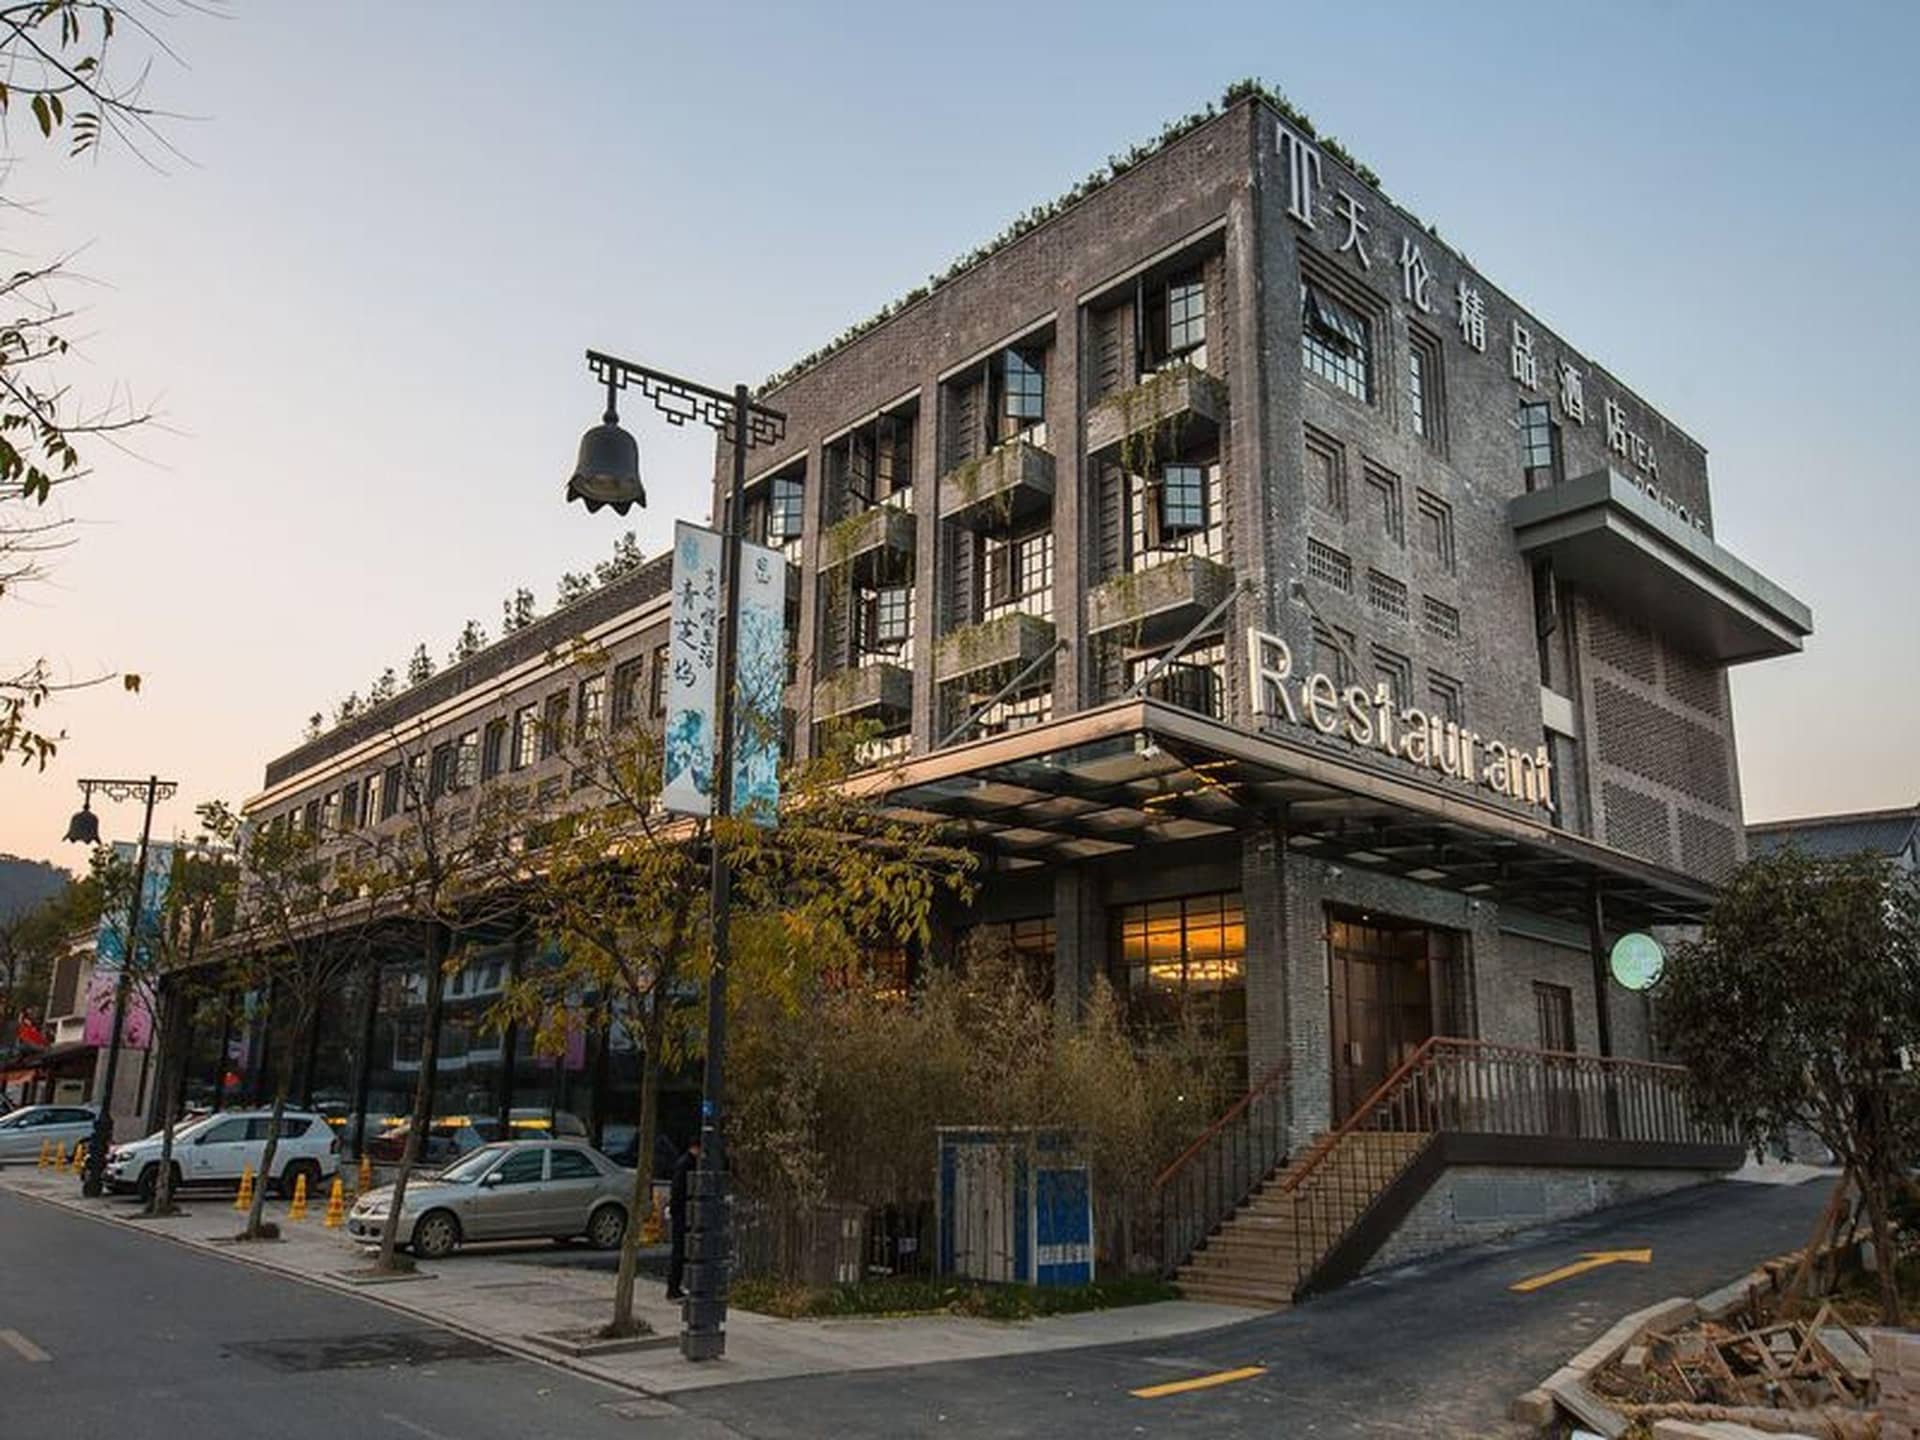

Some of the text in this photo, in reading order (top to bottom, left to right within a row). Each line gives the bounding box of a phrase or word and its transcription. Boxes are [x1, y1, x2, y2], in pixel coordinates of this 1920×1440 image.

[1334, 189, 1627, 458] 天伦精品酒店
[1626, 430, 1660, 481] TEA
[1247, 626, 1555, 812] Restaurant
